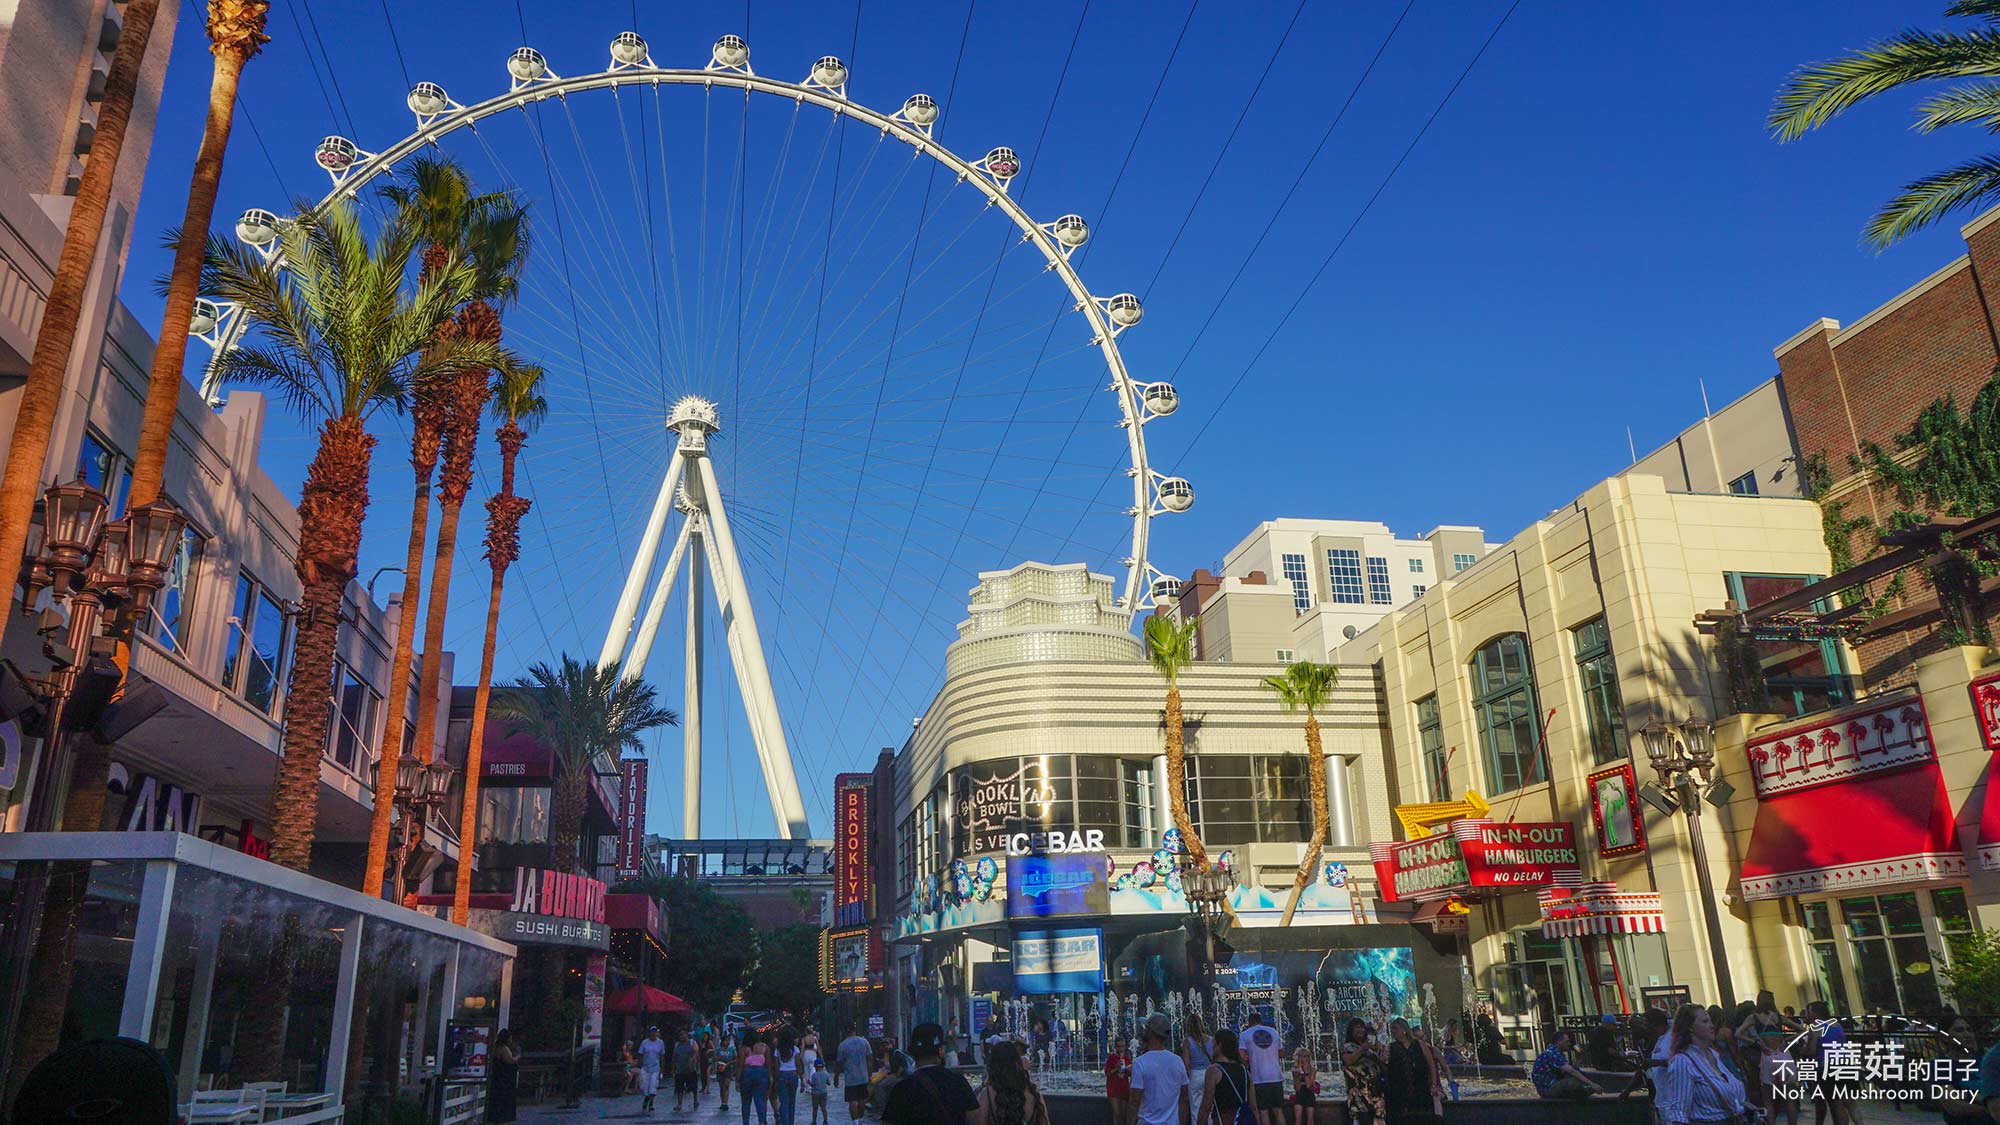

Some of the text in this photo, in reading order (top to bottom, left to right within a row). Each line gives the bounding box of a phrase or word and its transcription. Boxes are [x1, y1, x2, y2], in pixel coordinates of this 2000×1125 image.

[490, 764, 526, 775] PASTRIES
[962, 784, 1045, 817] BROOKLYN
[626, 763, 638, 869] FAVORITE
[980, 802, 1017, 818] BOWL
[1005, 829, 1105, 855] ICEBAR
[1482, 828, 1565, 845] IN-N-OUT
[1399, 837, 1457, 869] IN-N-OUT
[1485, 848, 1577, 866] HAMBURGERS
[1494, 871, 1545, 882] NO DELAY
[515, 920, 602, 942] SUSHI BURRITOS
[1018, 940, 1096, 956] ICEBAR
[1338, 985, 1367, 999] ARCTIC
[1323, 999, 1352, 1012] GOST
